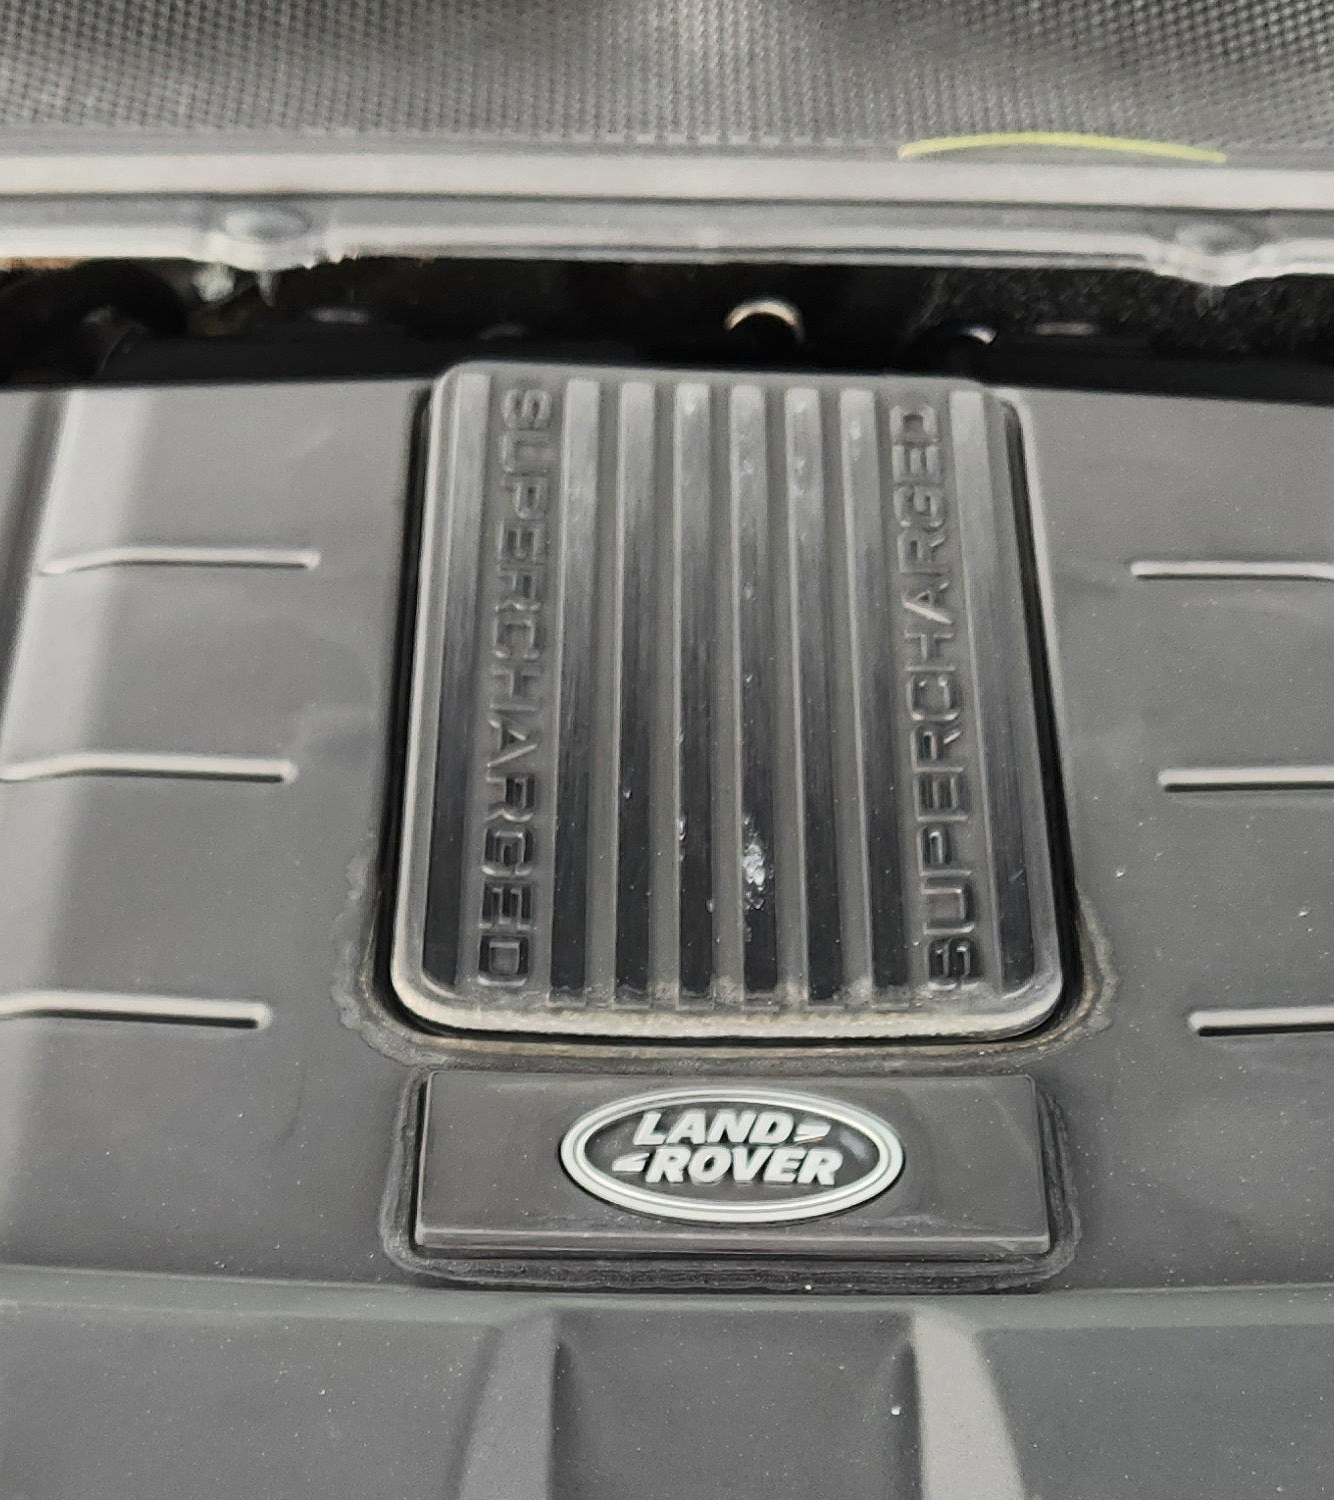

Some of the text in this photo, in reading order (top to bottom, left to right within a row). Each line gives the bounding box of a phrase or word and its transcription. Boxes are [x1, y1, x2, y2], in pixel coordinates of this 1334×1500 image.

[478, 386, 551, 989] SUPERCHARGED
[889, 402, 977, 993] SUPERCHARGED
[634, 1109, 794, 1145] LAND
[644, 1147, 843, 1186] ROVER
